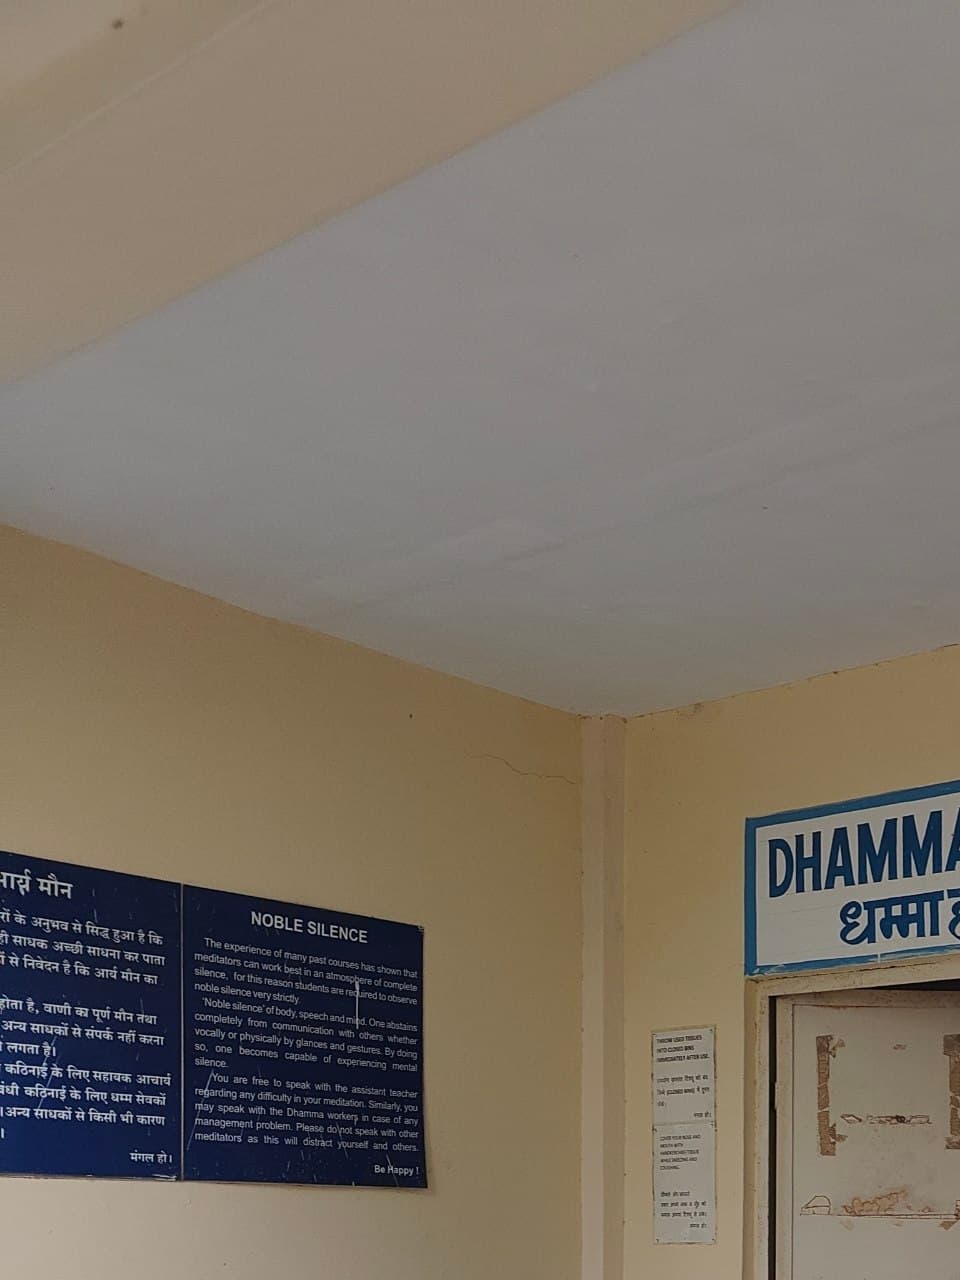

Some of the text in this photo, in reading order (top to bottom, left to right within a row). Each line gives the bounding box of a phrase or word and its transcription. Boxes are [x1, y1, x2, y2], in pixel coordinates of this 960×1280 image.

[36, 873, 73, 898] मौन
[13, 910, 26, 924] के
[32, 917, 69, 932] अनुभव
[71, 919, 82, 933] से
[112, 929, 134, 943] हुआ
[147, 930, 163, 944] कि
[251, 911, 367, 943] NOBLE SILENCE
[839, 890, 944, 945] धम्मा
[11, 935, 48, 949] साधक
[86, 945, 119, 959] साधना
[123, 951, 139, 962] कर
[141, 953, 165, 965] पाता
[203, 937, 417, 978] The experience many past courses has shown that
[8, 952, 19, 966] से
[22, 954, 59, 972] निवेदन
[73, 961, 90, 975] कि
[94, 966, 117, 979] आर्य
[120, 968, 140, 982] मौन
[143, 974, 158, 984] का
[194, 953, 241, 966] meditators
[243, 960, 259, 969] can
[261, 963, 281, 972] work
[284, 964, 302, 975] best
[194, 983, 271, 1001] noble silence very
[233, 971, 245, 981] for
[247, 974, 262, 984] this
[264, 978, 292, 987] reason
[330, 987, 344, 995] are
[387, 994, 417, 1005] observe
[42, 1002, 71, 1015] वाणी
[91, 1006, 110, 1022] पूर्ण
[113, 1008, 133, 1022] मौन
[136, 1014, 157, 1024] तथा
[299, 1011, 385, 1027] speech and One
[1, 1020, 164, 1045] अन्य साधकों से संपर्क नहीं करना
[194, 1013, 242, 1027] completely
[247, 1017, 267, 1027] from
[338, 1030, 354, 1038] with
[359, 1031, 383, 1041] others
[5, 1042, 39, 1054] लगता
[194, 1028, 225, 1040] vocally
[239, 1032, 281, 1046] physically
[329, 1042, 344, 1050] and
[396, 1049, 417, 1060] doing
[194, 1043, 317, 1061] so, one becomes capable
[4, 1060, 48, 1079] कठिनाई
[50, 1063, 63, 1080] के
[66, 1064, 90, 1082] लिए
[23, 1083, 66, 1101] कठिनाई
[69, 1085, 81, 1099] के
[84, 1087, 108, 1104] लिए
[111, 1092, 132, 1103] धम्म
[135, 1090, 166, 1105] सेवकों
[211, 1072, 417, 1097] You are free speak with the teacher
[239, 1092, 255, 1101] any
[303, 1097, 321, 1105] your
[5, 1107, 30, 1117] अन्य
[33, 1102, 72, 1120] साधकों
[74, 1107, 85, 1120] से
[88, 1108, 116, 1122] किसी
[136, 1115, 165, 1125] कारण
[195, 1103, 214, 1113] may
[217, 1104, 244, 1114] speak
[248, 1105, 265, 1114] with
[269, 1107, 283, 1116] the
[287, 1107, 324, 1118] Dhamma
[404, 1118, 418, 1126] any
[194, 1117, 253, 1129] management
[296, 1122, 324, 1132] Please
[355, 1127, 378, 1136] speak
[398, 1130, 418, 1138] other
[195, 1132, 242, 1142] meditators
[263, 1135, 279, 1144] this
[284, 1136, 297, 1144] will
[372, 1142, 387, 1150] and
[129, 1150, 172, 1163] मंगल हो।
[374, 1164, 413, 1176] Be Happy
